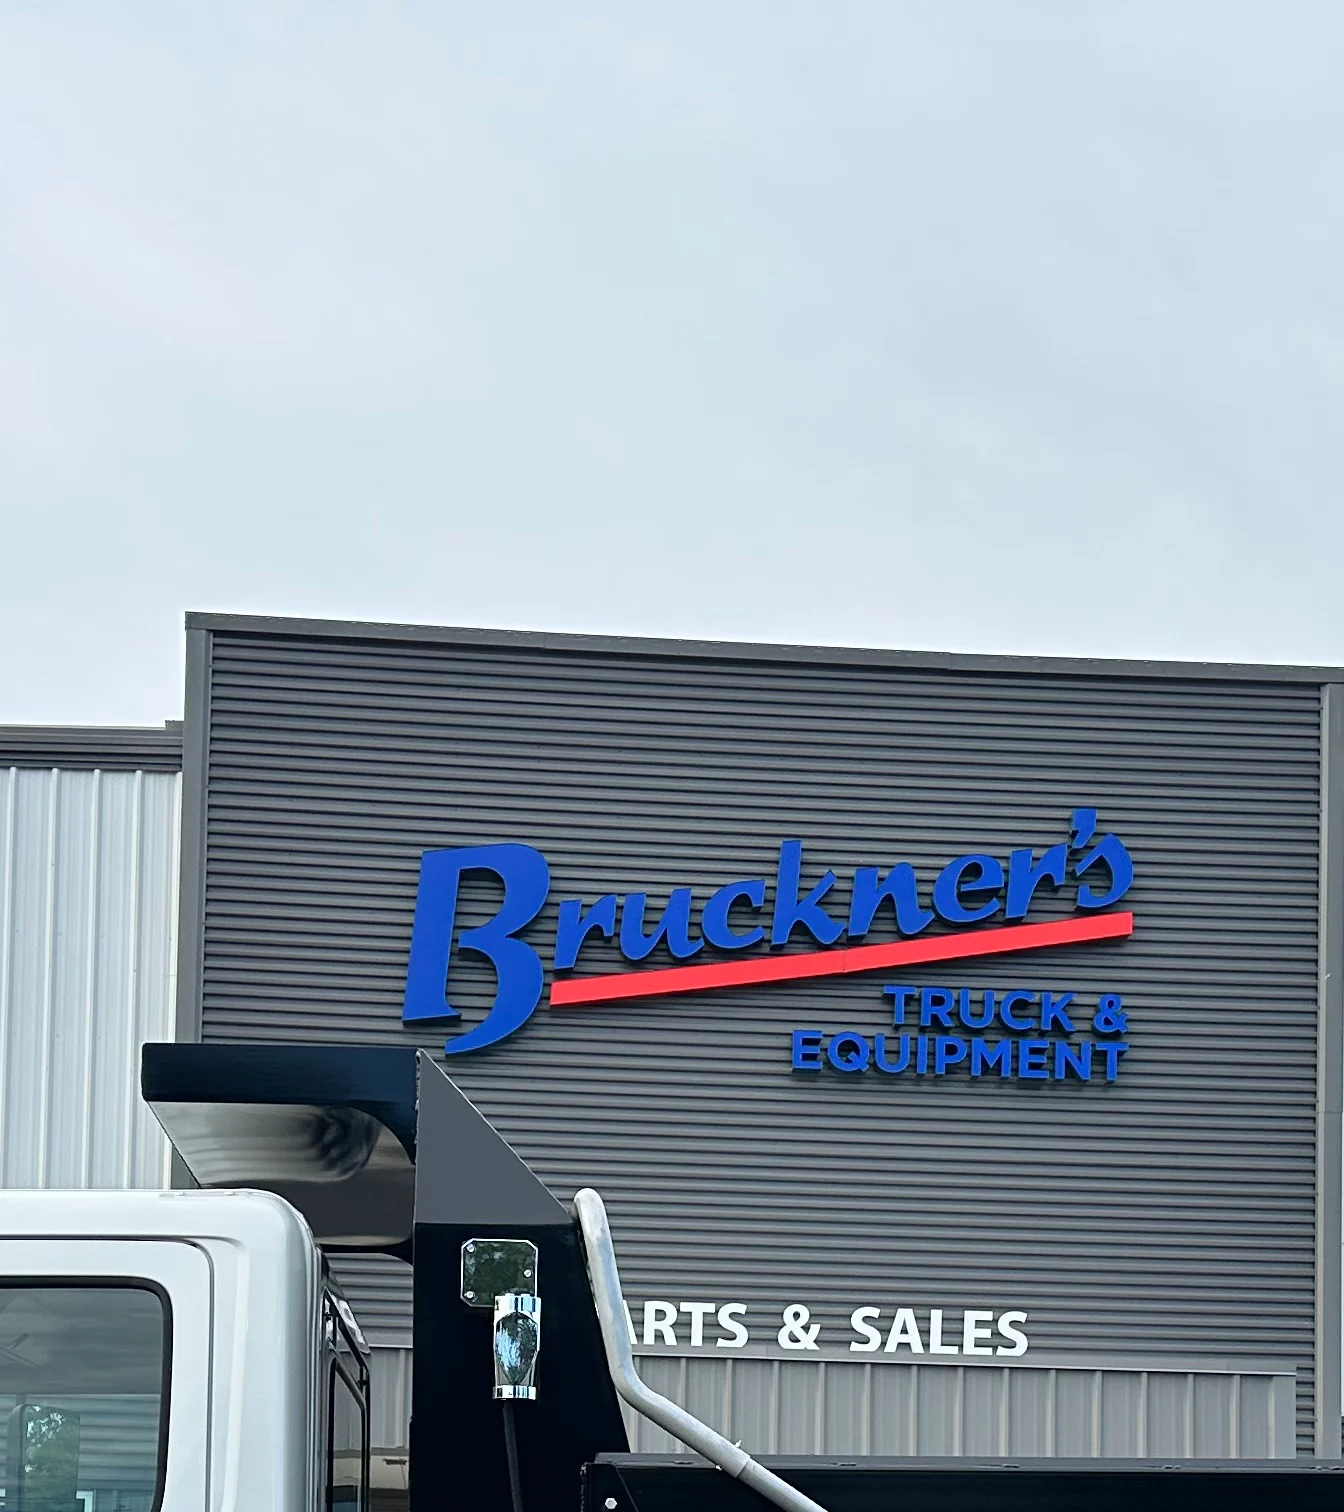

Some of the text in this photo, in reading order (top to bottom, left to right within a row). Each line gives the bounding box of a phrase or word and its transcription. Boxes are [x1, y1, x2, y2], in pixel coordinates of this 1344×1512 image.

[402, 808, 1134, 1055] Bruckner's
[881, 984, 1129, 1035] TRUCK &
[792, 1028, 1129, 1082] EQUIPMENT
[622, 1299, 1029, 1357] RTS & SALES
